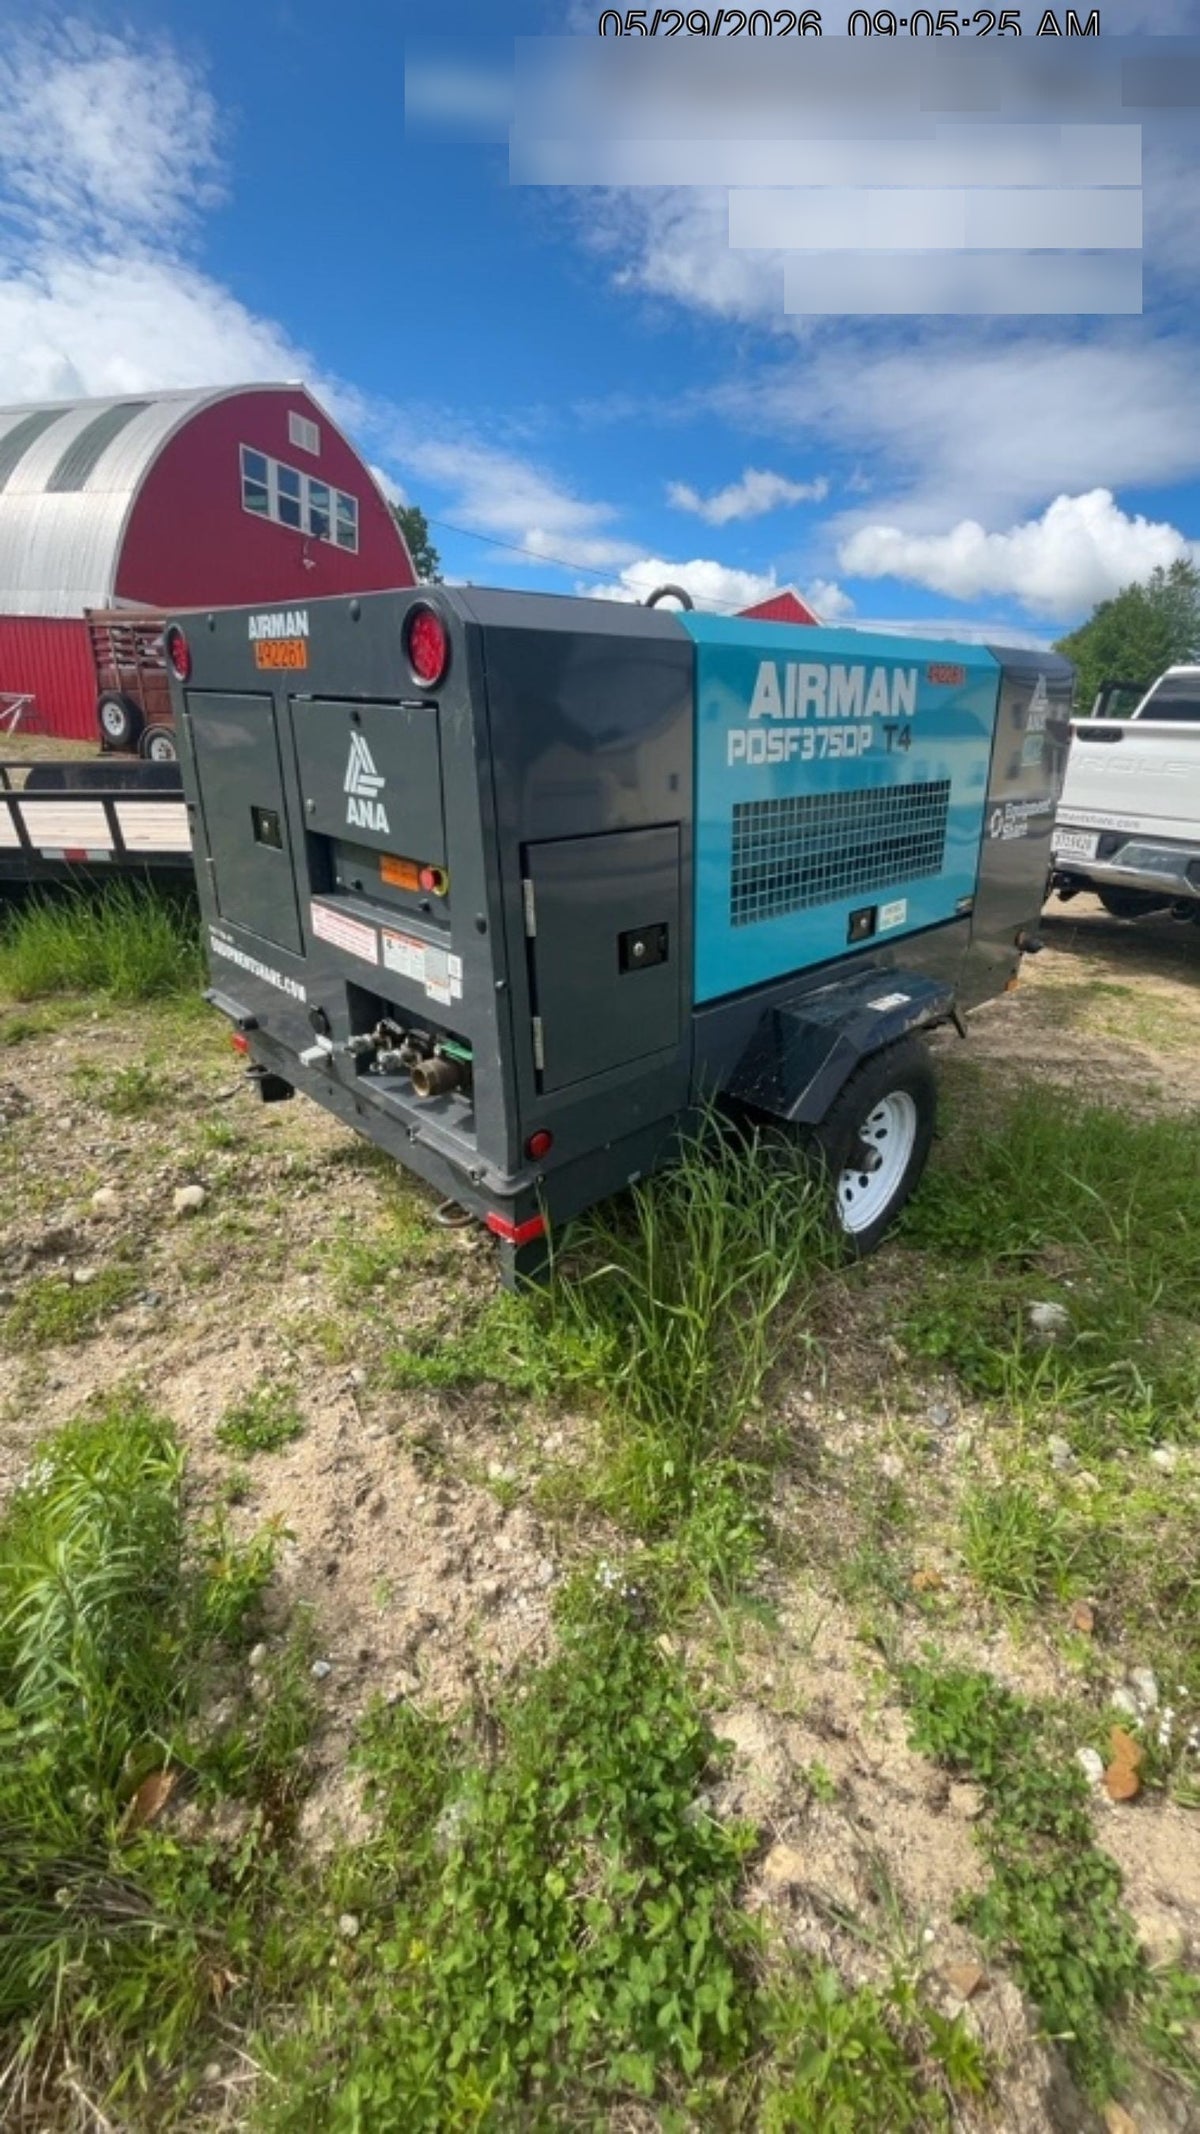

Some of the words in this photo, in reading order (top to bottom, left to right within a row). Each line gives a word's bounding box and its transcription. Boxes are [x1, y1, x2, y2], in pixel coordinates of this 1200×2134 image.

[248, 609, 309, 640] AIRMAN
[749, 661, 918, 719] AIRMAN
[884, 724, 911, 752] T4
[346, 796, 390, 833] ANA
